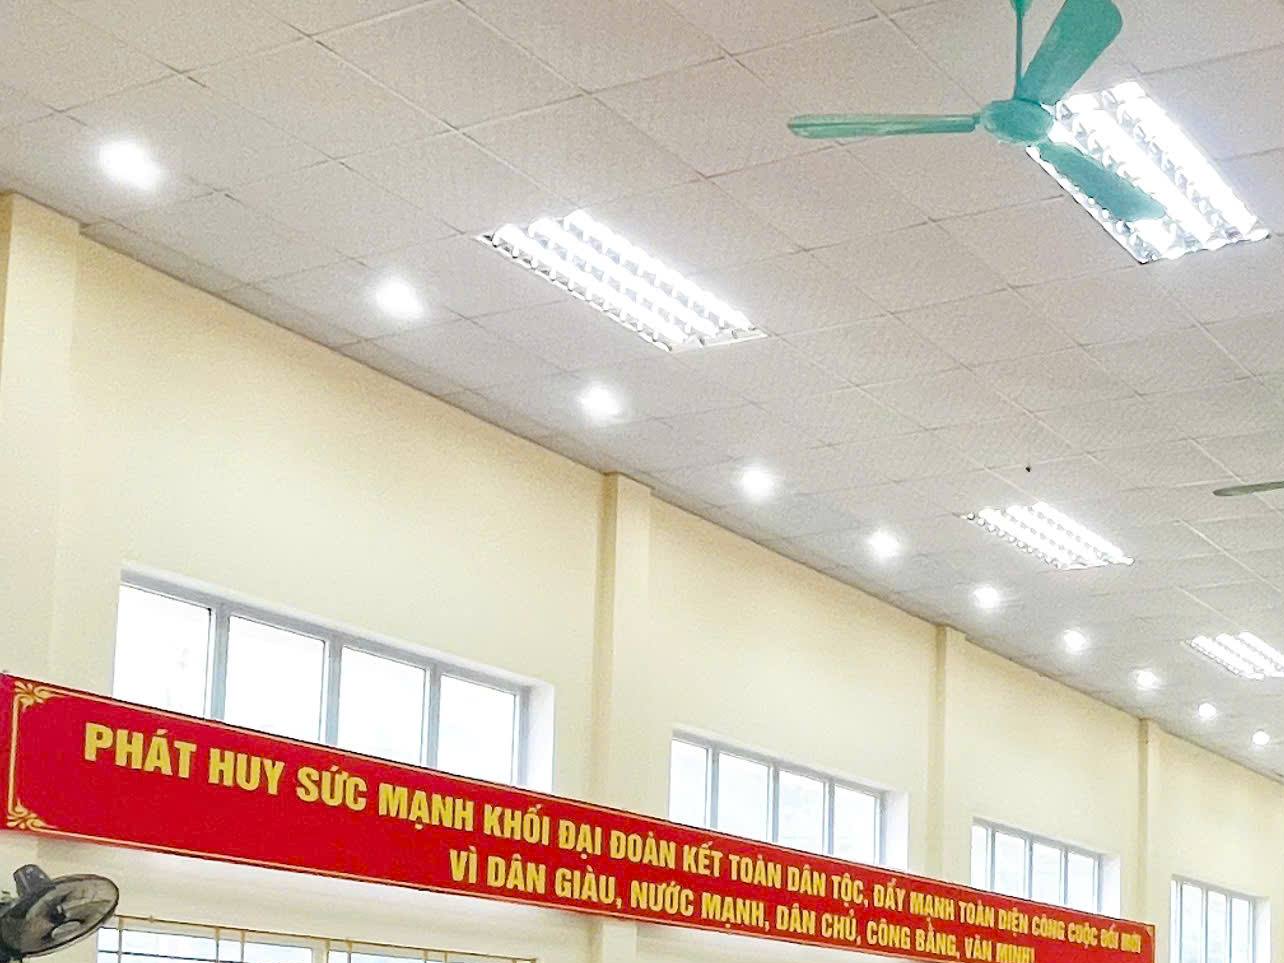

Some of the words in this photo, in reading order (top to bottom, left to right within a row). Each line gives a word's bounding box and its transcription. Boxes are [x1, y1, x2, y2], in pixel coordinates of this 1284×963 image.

[84, 721, 197, 779] PHÁT
[208, 747, 285, 795] HUY
[296, 764, 368, 812] SỨC
[378, 782, 475, 832] MẠNH
[483, 803, 551, 846] KHỐI
[558, 818, 602, 860] ĐẠI
[609, 829, 677, 870] ĐOÀN
[682, 840, 723, 878] KẾT
[728, 853, 782, 889] TOÀN
[787, 863, 827, 898] DÂN
[831, 872, 869, 909] TỘC,
[909, 890, 955, 921] MẠNH
[958, 899, 995, 928] TOÀN
[998, 906, 1029, 938] DIỆN
[1031, 913, 1066, 942] CÔNG
[449, 845, 478, 884] VÌ
[487, 852, 547, 895] DÂN
[555, 864, 623, 910] GIÀU,
[630, 879, 695, 917] NƯỚC
[701, 891, 771, 932] MẠNH,
[776, 902, 817, 936] DÂN
[821, 908, 862, 946] CHỦ,
[866, 917, 911, 950] CÔNG
[915, 917, 961, 960] BẰNG,
[964, 933, 993, 962] VĂN
